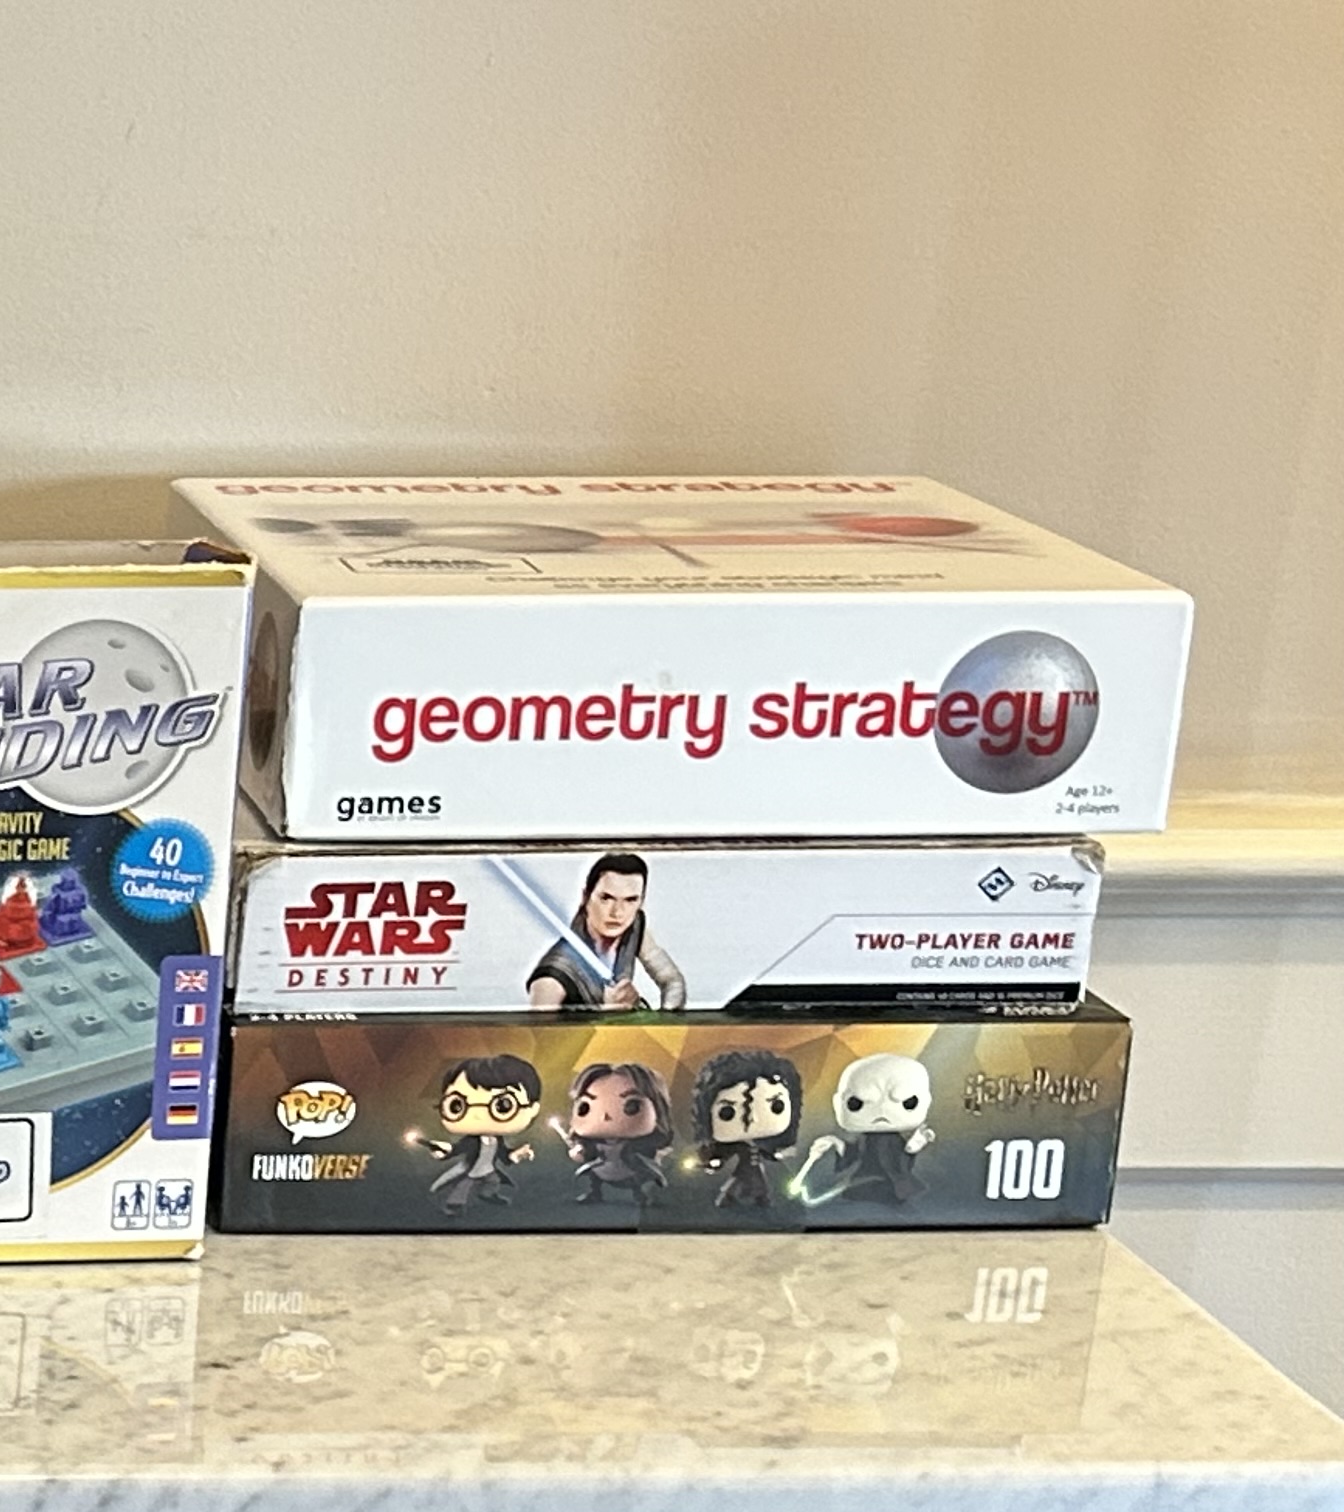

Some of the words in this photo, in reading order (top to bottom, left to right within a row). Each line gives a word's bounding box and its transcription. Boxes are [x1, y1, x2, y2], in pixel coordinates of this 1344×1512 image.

[371, 683, 727, 760] geometry
[749, 680, 1070, 758] strategy
[1065, 786, 1089, 798] Age
[337, 795, 441, 822] games
[1077, 802, 1120, 816] players
[27, 837, 71, 861] GAME
[149, 836, 183, 867] 40
[122, 880, 195, 904] Challenges!
[1028, 871, 1085, 897] Disney
[285, 881, 467, 919] STAR
[284, 919, 465, 957] WARS
[855, 932, 1001, 950] TWO-PLAYER
[1010, 932, 1076, 950] GAME
[912, 955, 944, 969] DICE
[948, 955, 980, 968] AND
[984, 955, 1024, 968] CARD
[1028, 955, 1071, 969] GAME
[287, 966, 448, 988] DESTINY
[280, 1089, 354, 1127] POP!
[252, 1153, 374, 1181] FUNKOVERSE
[984, 1138, 1065, 1200] 100
